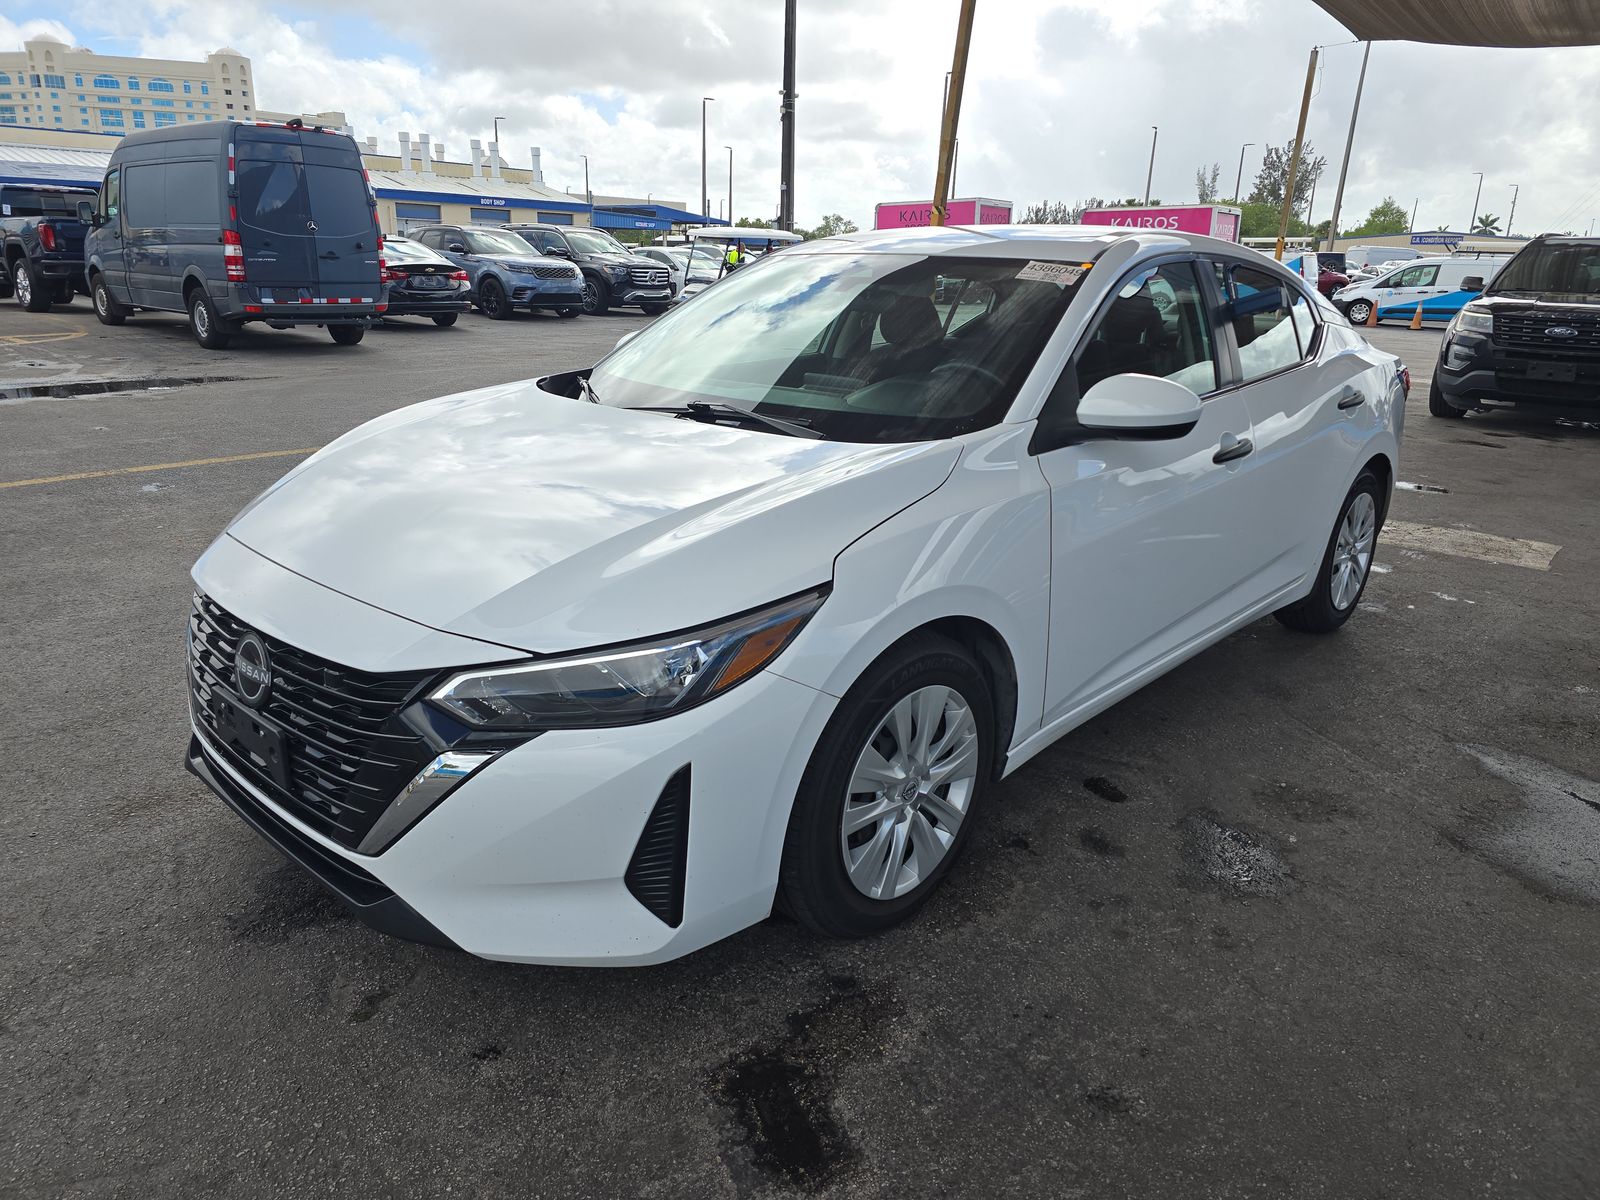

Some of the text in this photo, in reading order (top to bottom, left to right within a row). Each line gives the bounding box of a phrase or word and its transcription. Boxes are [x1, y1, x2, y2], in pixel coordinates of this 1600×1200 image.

[899, 208, 951, 222] KAIRS
[1111, 216, 1179, 230] KAIROS
[1027, 263, 1084, 277] 4386049
